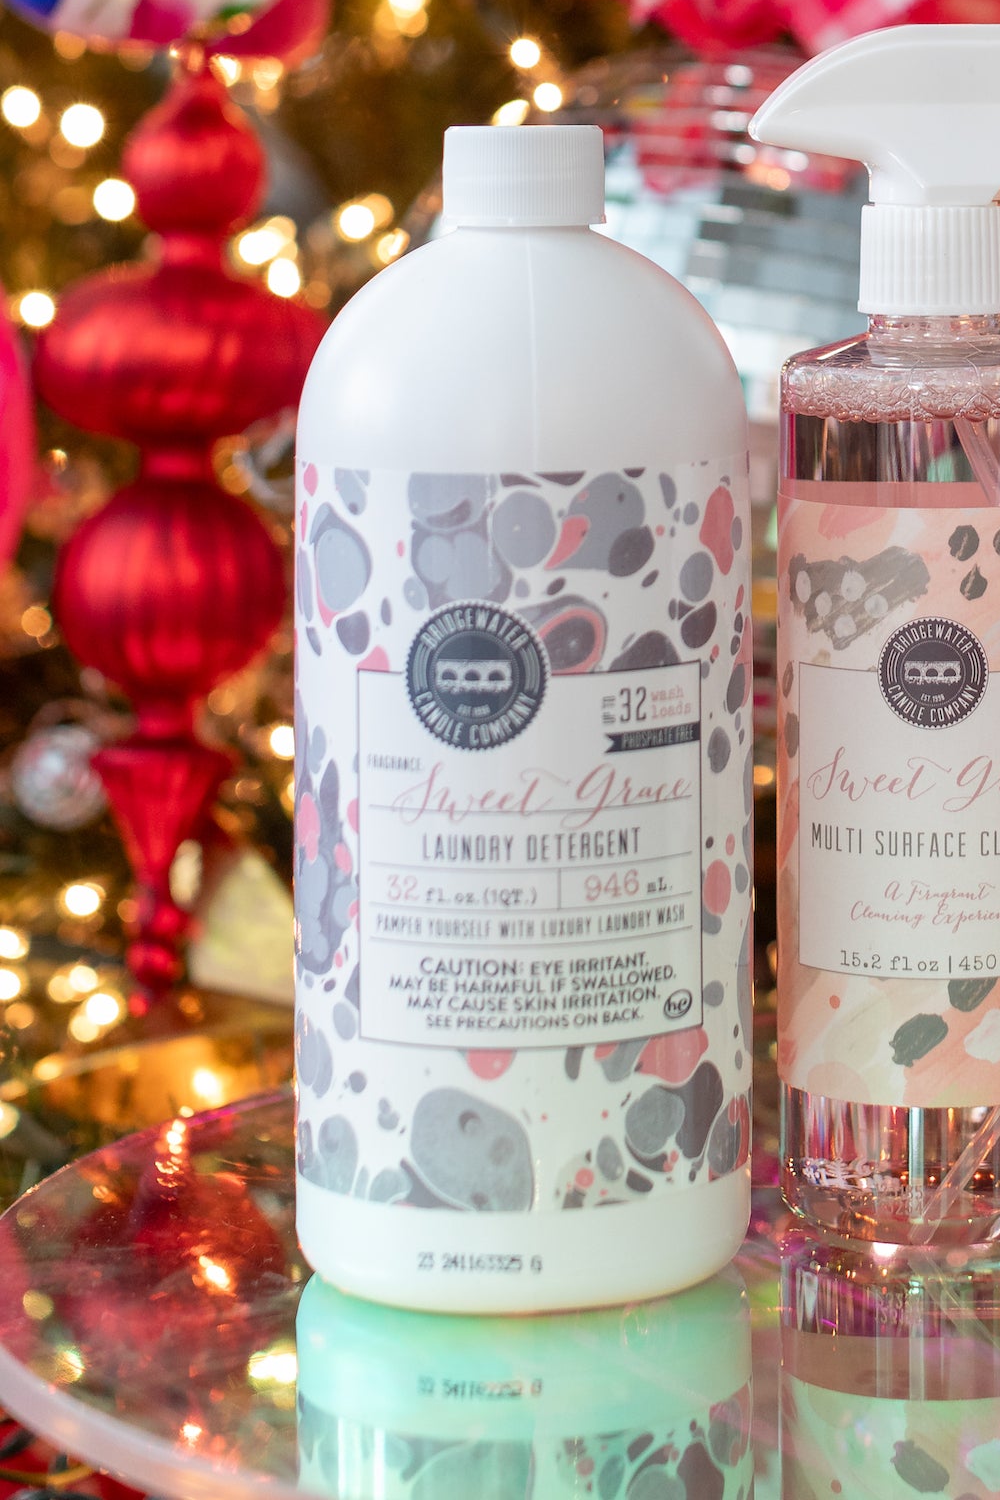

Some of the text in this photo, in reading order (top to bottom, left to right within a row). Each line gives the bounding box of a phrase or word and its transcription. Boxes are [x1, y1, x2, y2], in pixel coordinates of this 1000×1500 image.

[421, 608, 529, 650] BRIDGEWATER
[893, 624, 973, 653] BRIDGEWATER
[620, 686, 647, 723] 32
[650, 685, 684, 701] wash
[888, 684, 978, 722] CANDLE COMPANY
[415, 691, 536, 746] CANDLE COMPANY
[651, 701, 691, 719] loads
[622, 724, 694, 749] PHOSPHATE FREE
[807, 746, 952, 801] Sweet
[391, 760, 692, 829] Sweet Grace
[422, 826, 640, 861] LAUNDRY DETERGENT
[811, 822, 862, 854] MULTI
[875, 830, 966, 858] SURFACE
[387, 874, 418, 901] 32
[584, 869, 640, 902] 946
[884, 880, 996, 905] A Fragrant
[377, 903, 685, 938] PAMPER YOURSELF WITH LUXURY LAUNDRY WASH
[850, 900, 925, 929] Cleaning
[420, 951, 650, 976] CAUTION: EYE IRRITANT.
[840, 950, 882, 970] 15.2
[890, 956, 912, 971] fl
[917, 960, 939, 972] oz
[959, 954, 997, 971] 450
[390, 964, 677, 993] MAY BE HARMFUL IF SWALLOWED.
[408, 985, 661, 1012] MAY CAUSE SKIN IRRITATION.
[427, 1007, 644, 1030] SEE PRECAUTIONS ON BACK.
